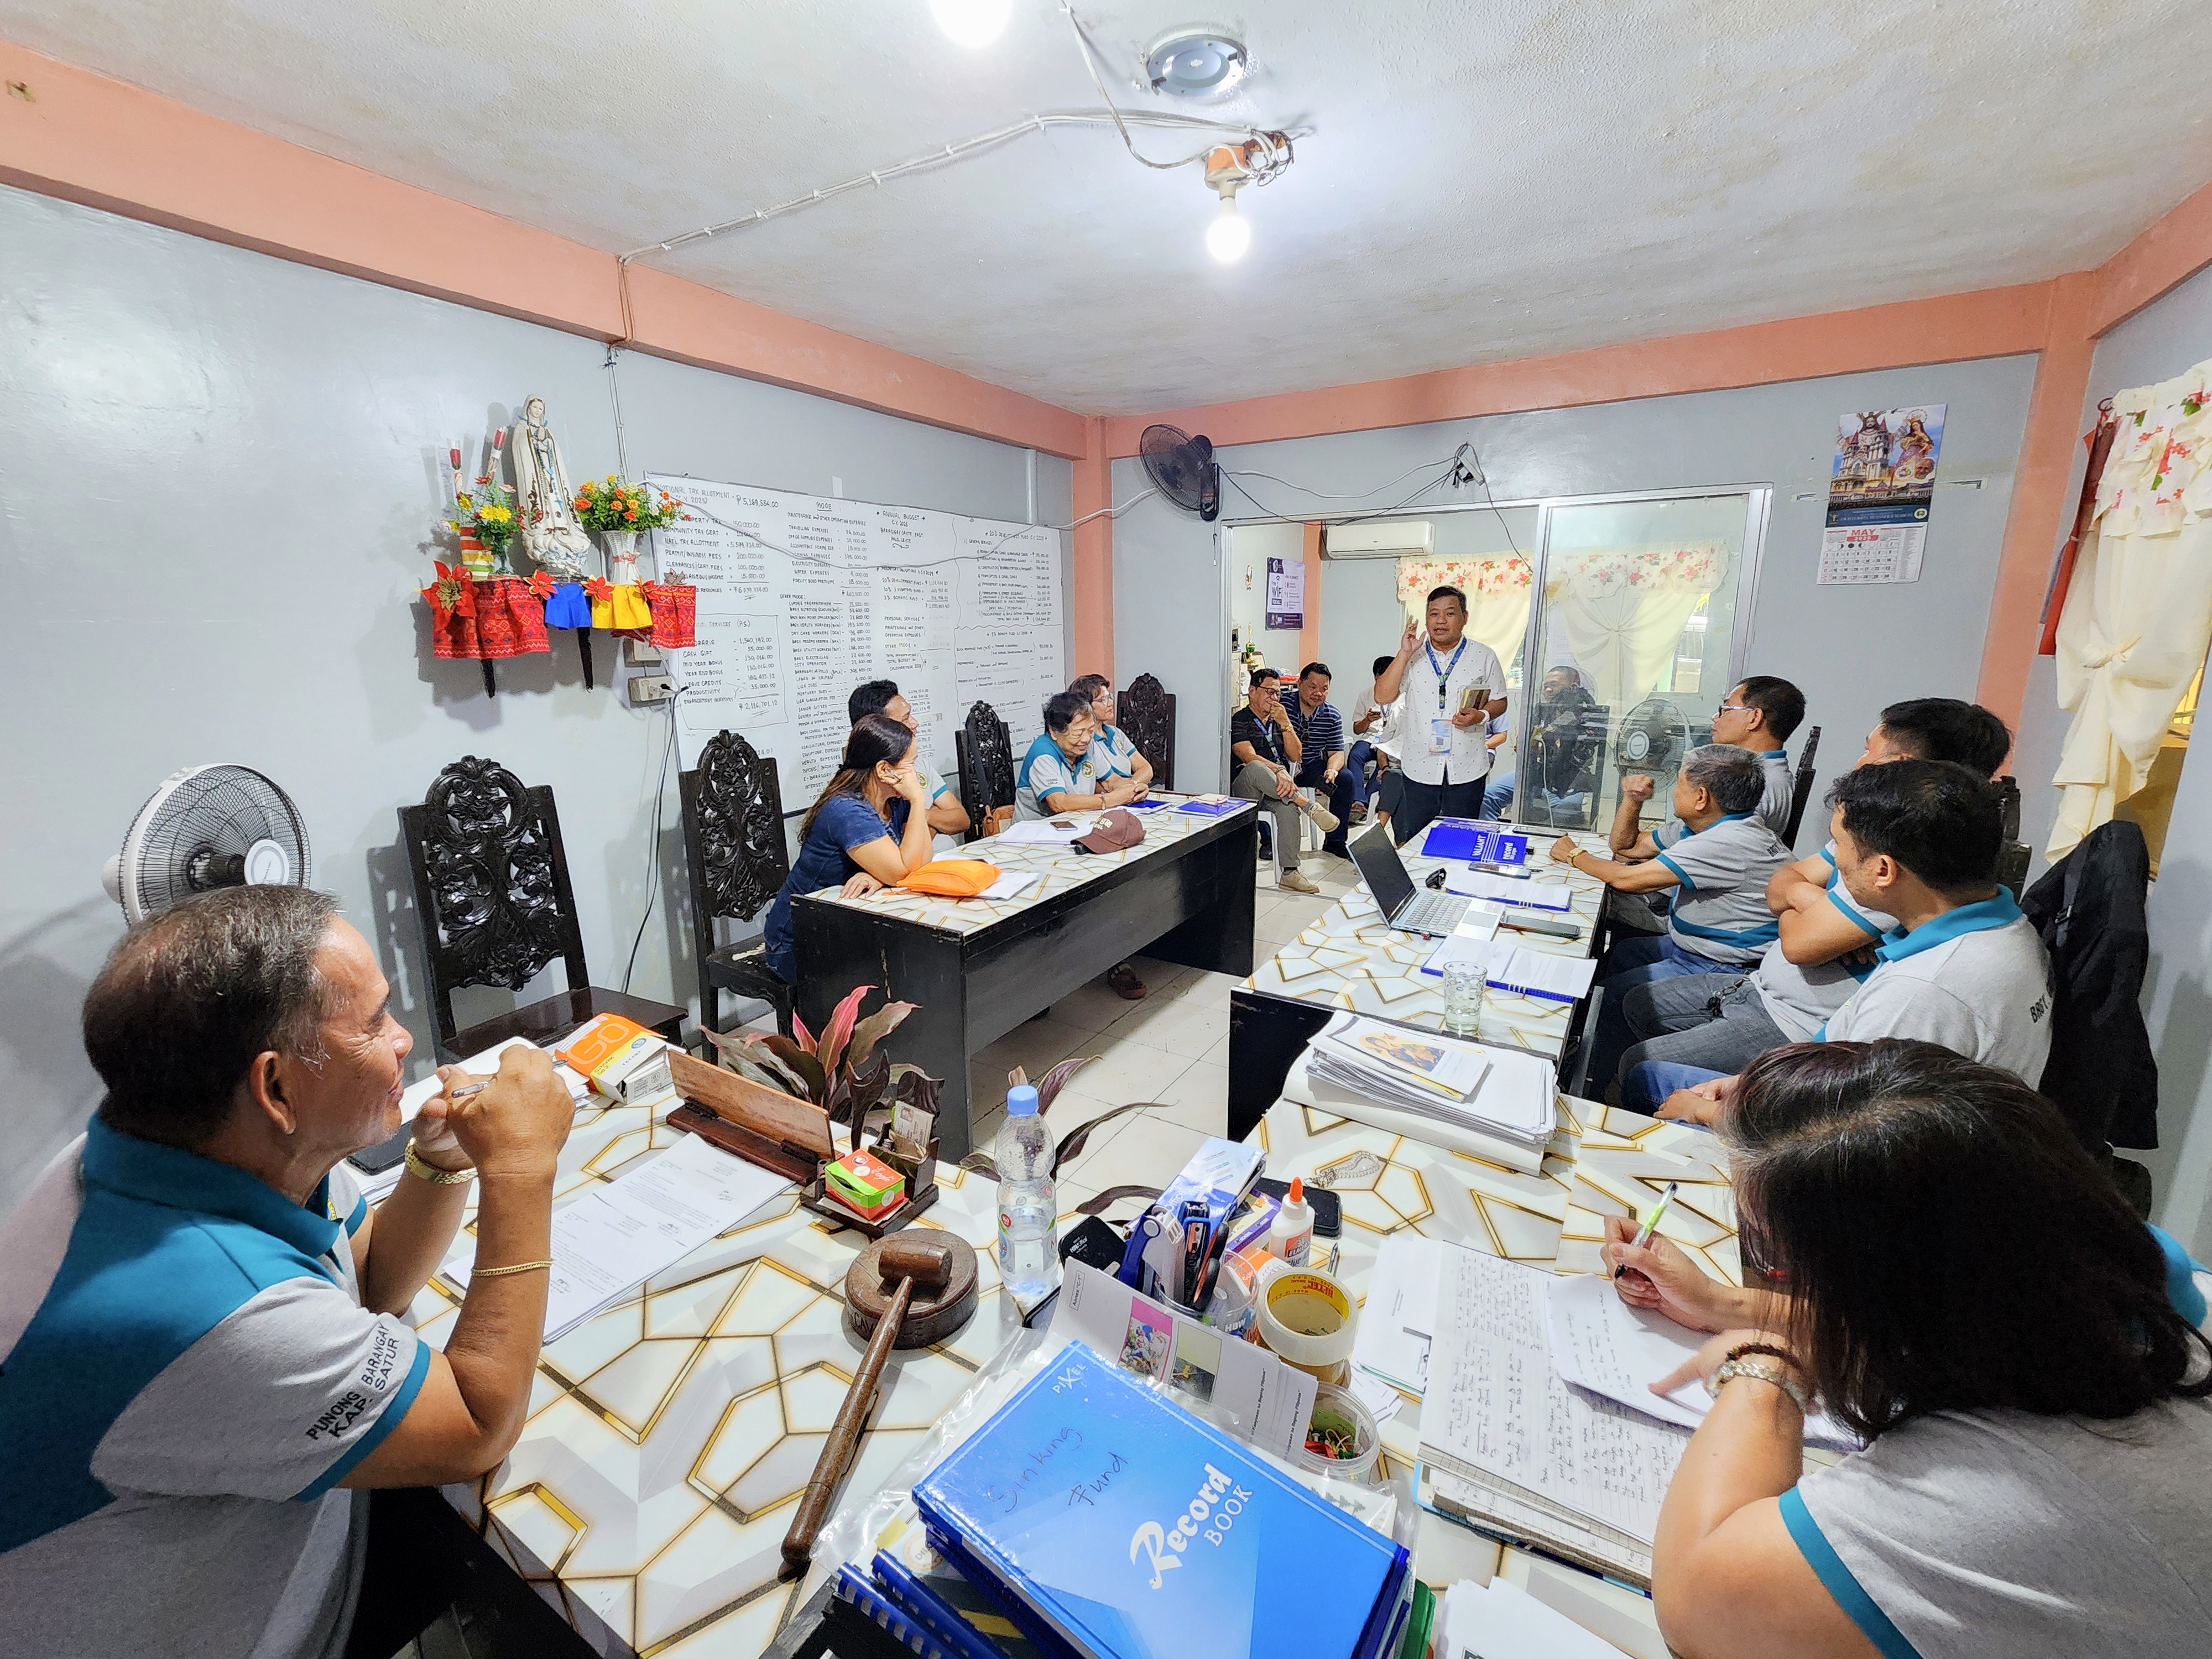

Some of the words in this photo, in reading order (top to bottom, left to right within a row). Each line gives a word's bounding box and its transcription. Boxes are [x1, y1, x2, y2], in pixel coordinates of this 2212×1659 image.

[702, 489, 730, 498] ALLOTMENT
[691, 539, 719, 547] ALLOTMENT
[1472, 834, 1486, 857] VALIANT
[1503, 842, 1514, 860] record
[566, 1022, 629, 1065] GO
[622, 1051, 641, 1066] TECNO
[1225, 1317, 1245, 1333] HBW
[374, 1338, 399, 1391] SATUR
[305, 1391, 362, 1441] PUNONG
[361, 1322, 390, 1387] BARANGAY
[1066, 1450, 1130, 1509] Fund
[1129, 1462, 1234, 1591] Record
[1202, 1484, 1254, 1548] BOOK
